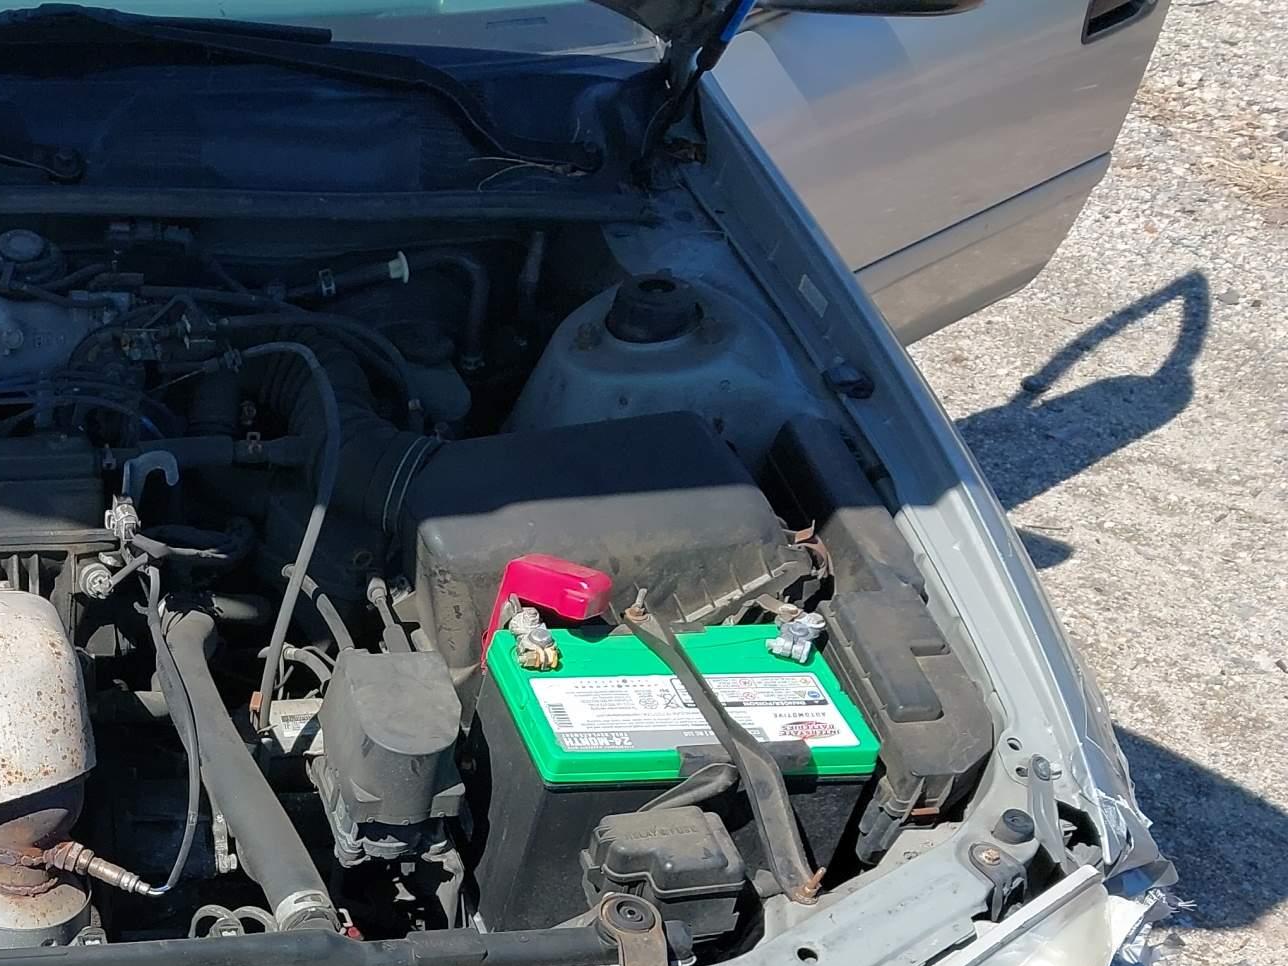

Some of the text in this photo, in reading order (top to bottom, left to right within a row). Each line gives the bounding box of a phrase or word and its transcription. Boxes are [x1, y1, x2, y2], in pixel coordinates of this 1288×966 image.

[773, 711, 826, 719] AUTOMOTIVE
[781, 723, 835, 731] BATTERIES
[778, 729, 840, 737] INTERSTATE
[562, 736, 633, 746] 24-MONTH
